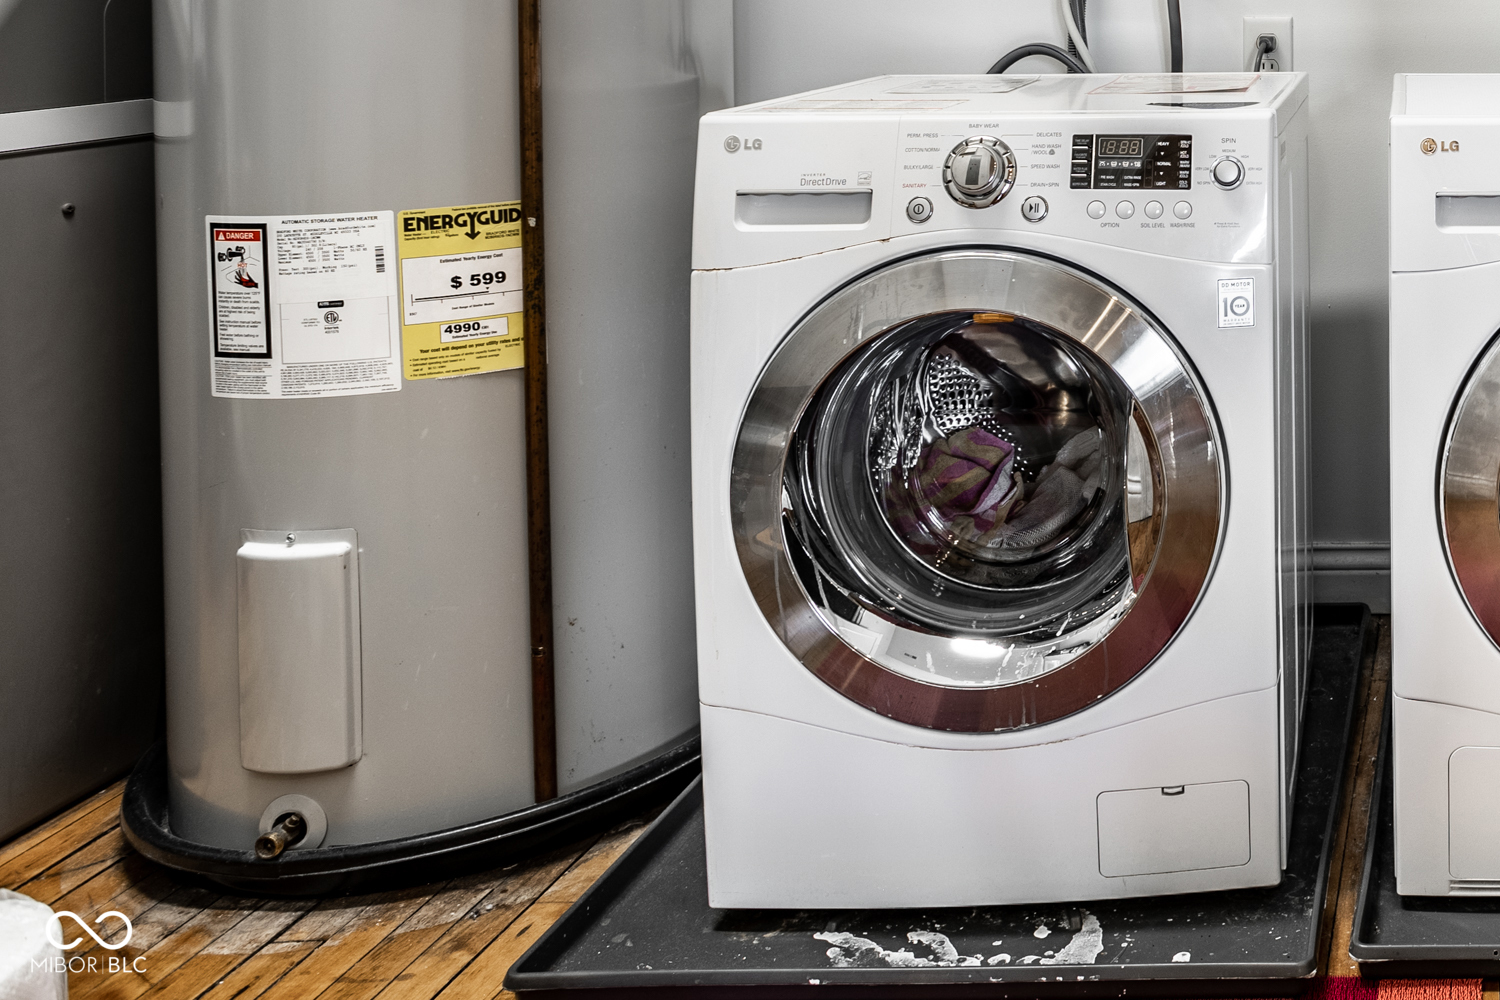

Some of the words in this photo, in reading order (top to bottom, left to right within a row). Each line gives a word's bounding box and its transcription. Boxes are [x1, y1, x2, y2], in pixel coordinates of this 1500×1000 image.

[744, 138, 763, 150] LG
[1441, 140, 1460, 152] LG
[403, 208, 522, 232] ENERGYGUID
[450, 275, 462, 289] $
[470, 271, 507, 286] 599
[1223, 296, 1250, 317] 10
[444, 321, 480, 334] 4990
